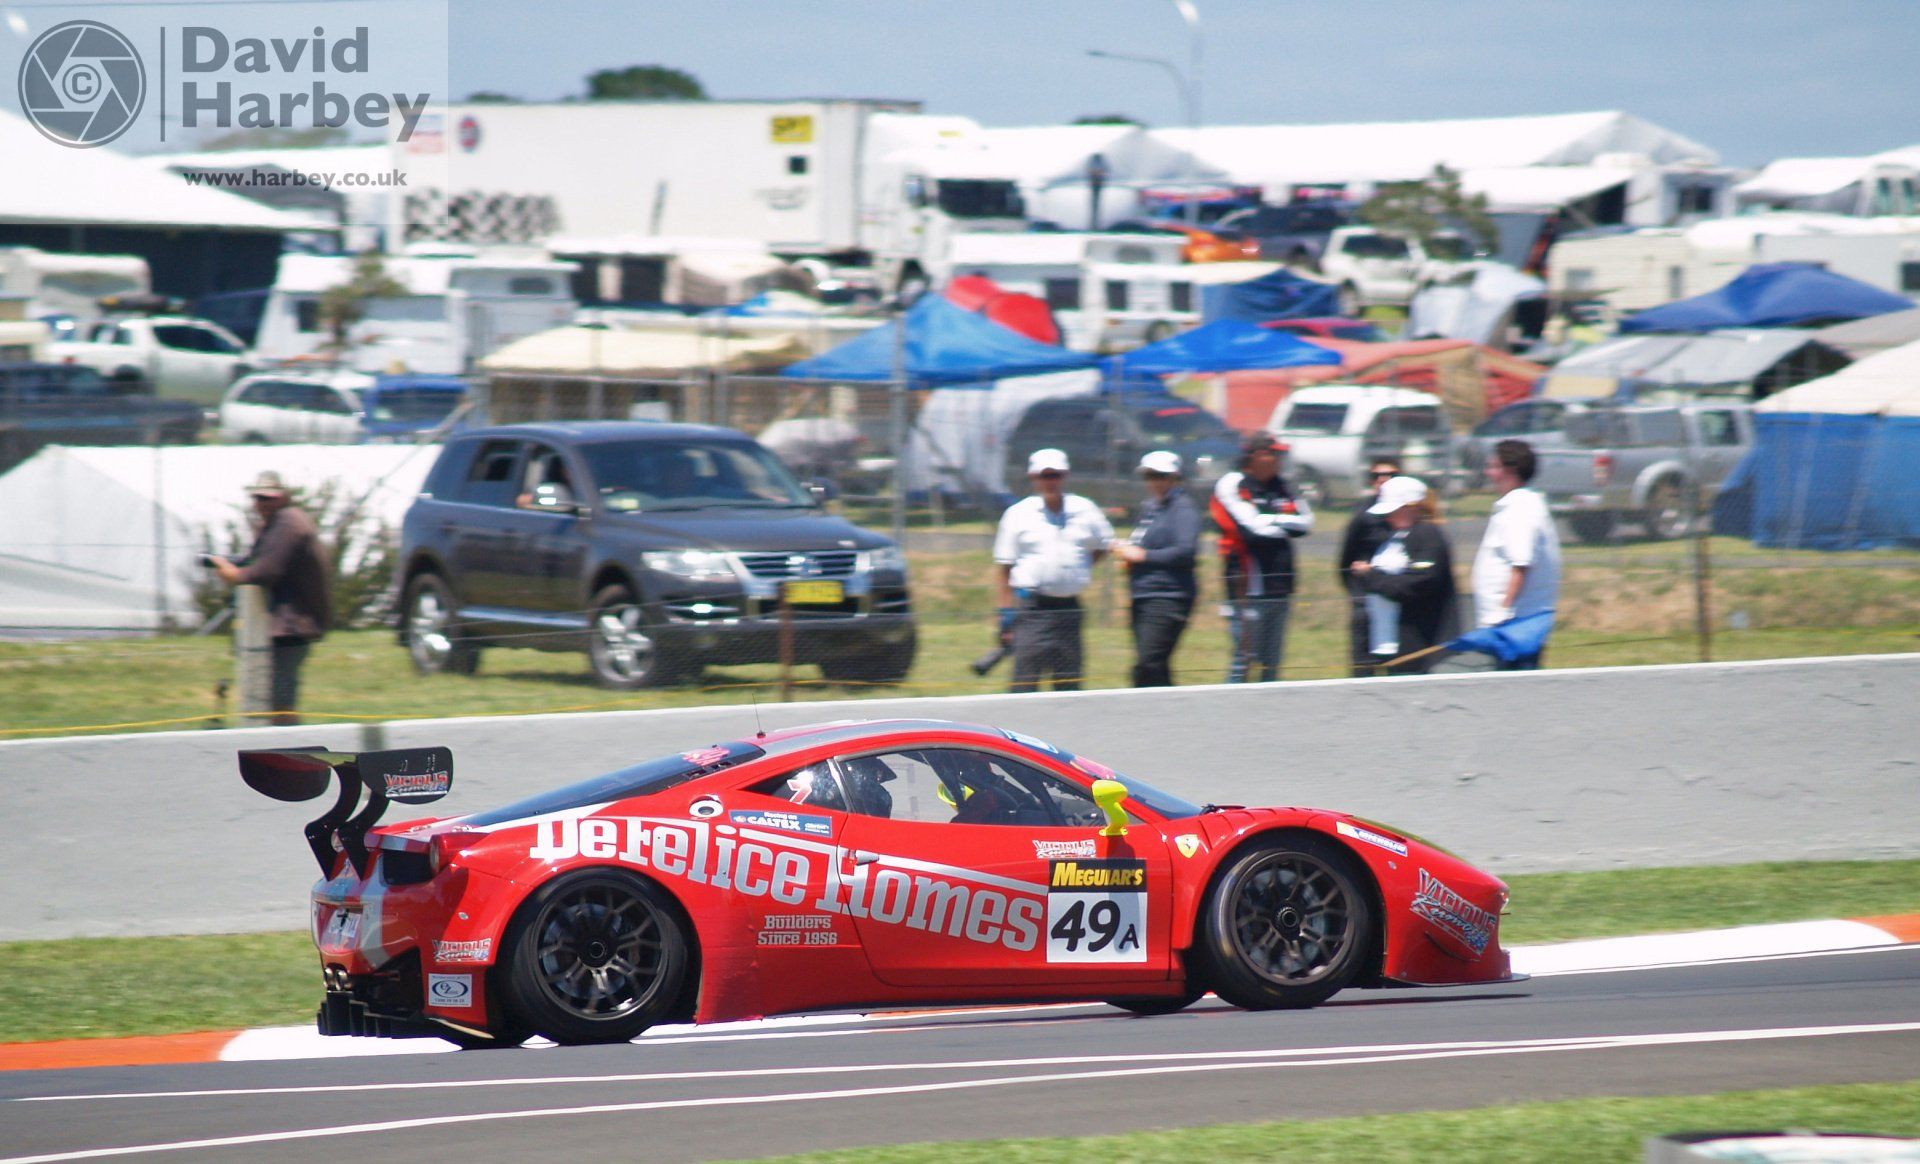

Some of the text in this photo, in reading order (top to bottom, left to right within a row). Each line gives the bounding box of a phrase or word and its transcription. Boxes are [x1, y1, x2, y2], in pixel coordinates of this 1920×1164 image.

[747, 815, 801, 831] CALTEX
[1051, 862, 1144, 887] MEGUIAR'S
[814, 844, 1044, 952] Homes
[763, 914, 833, 930] Builders
[757, 931, 838, 945] Since 1956
